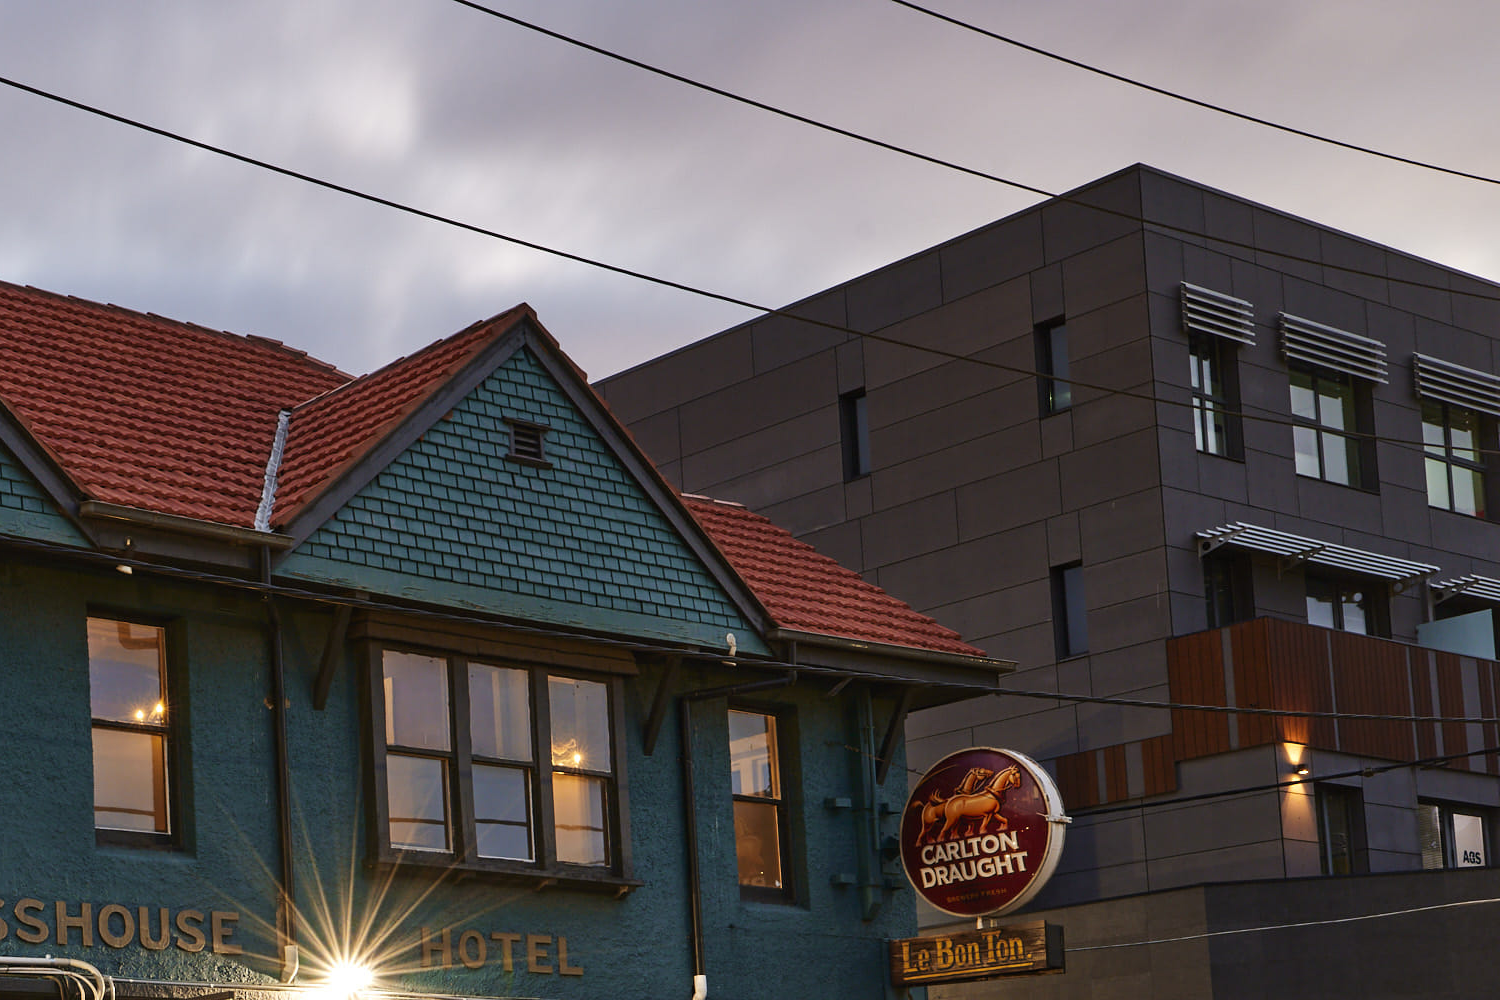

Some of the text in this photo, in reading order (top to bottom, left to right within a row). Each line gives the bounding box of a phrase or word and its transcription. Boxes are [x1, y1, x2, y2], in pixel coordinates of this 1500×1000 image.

[921, 831, 1019, 865] CARLTON
[919, 851, 1028, 889] DRAUGHT
[420, 927, 584, 976] HOTEL
[901, 942, 931, 974] Le
[936, 936, 982, 970] Bon
